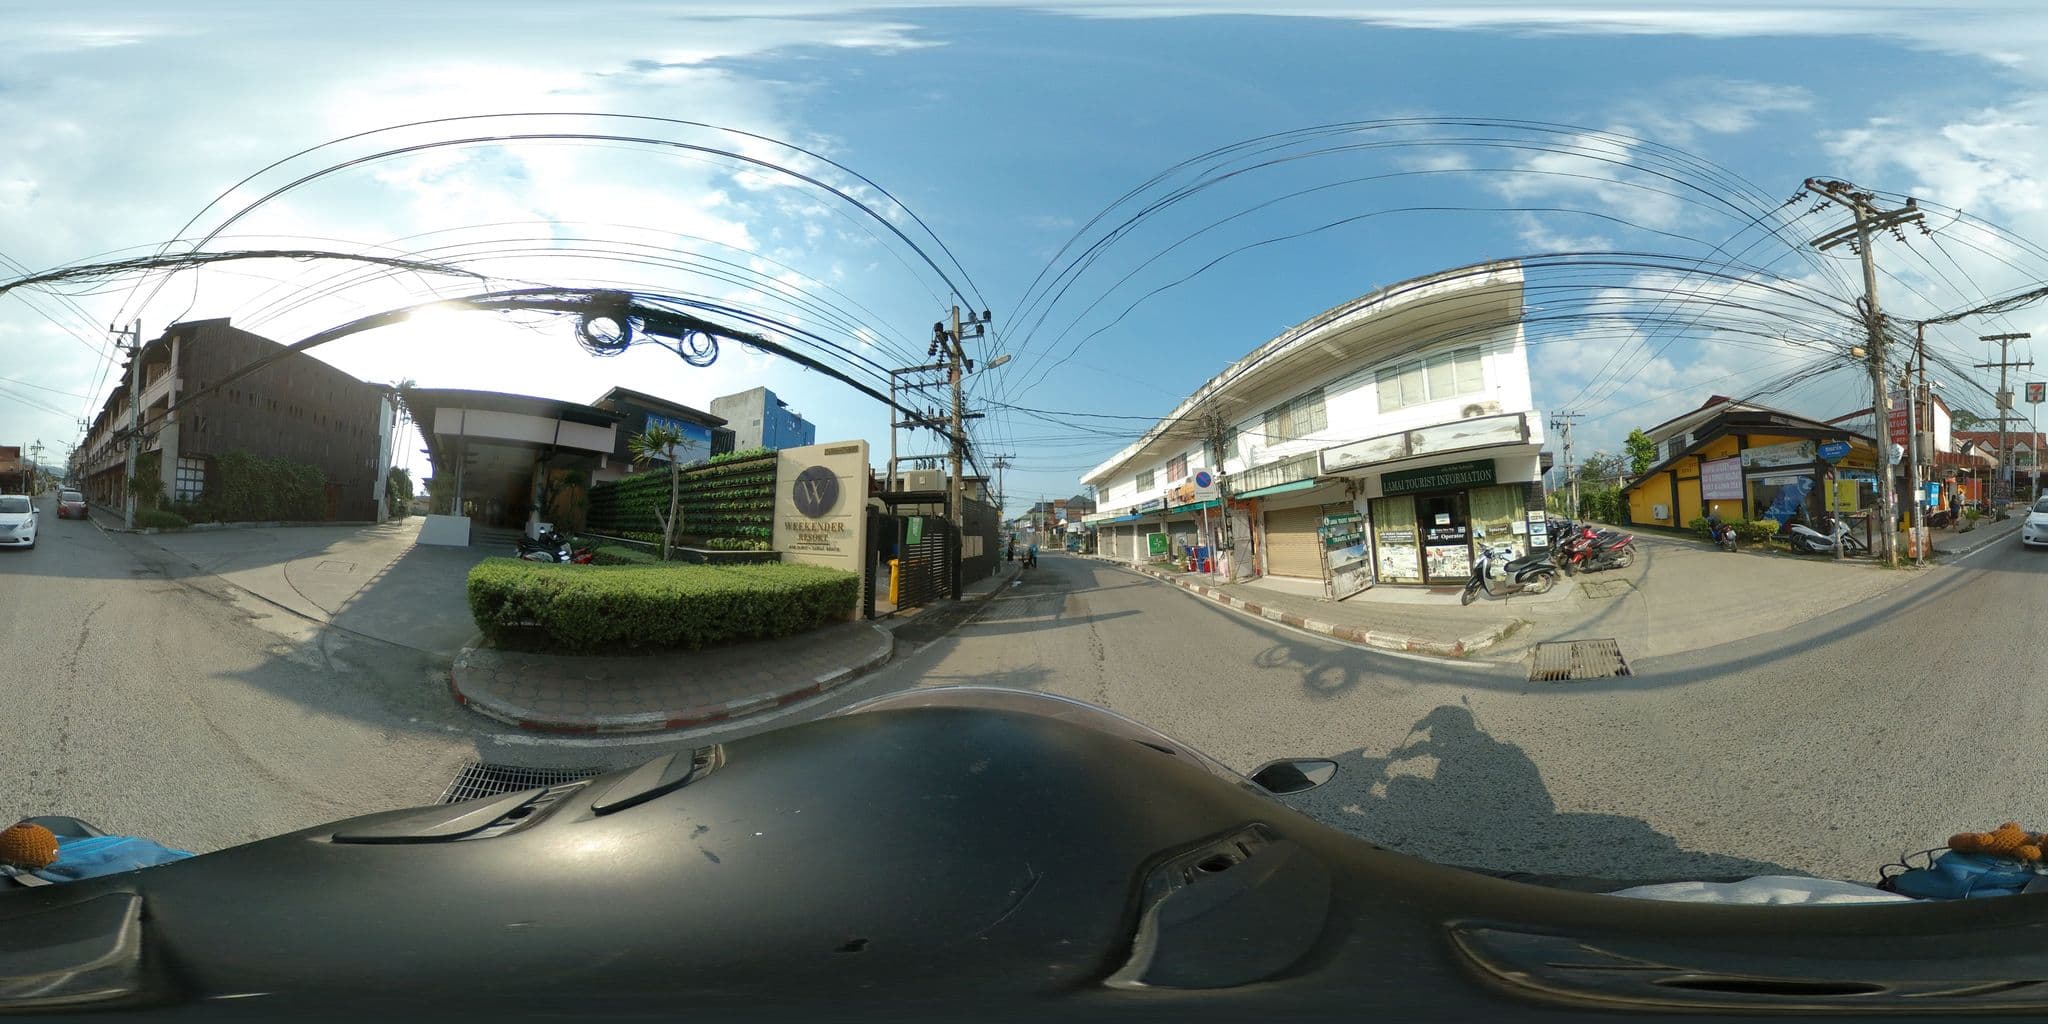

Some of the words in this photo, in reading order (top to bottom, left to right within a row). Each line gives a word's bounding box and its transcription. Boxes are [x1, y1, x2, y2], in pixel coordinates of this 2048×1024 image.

[1384, 480, 1405, 492] LAMAI
[1405, 475, 1436, 490] TOURIST
[1437, 469, 1492, 486] INFORMATION
[802, 480, 830, 505] W
[784, 521, 844, 532] WEEKENDER
[798, 533, 828, 542] RESORT
